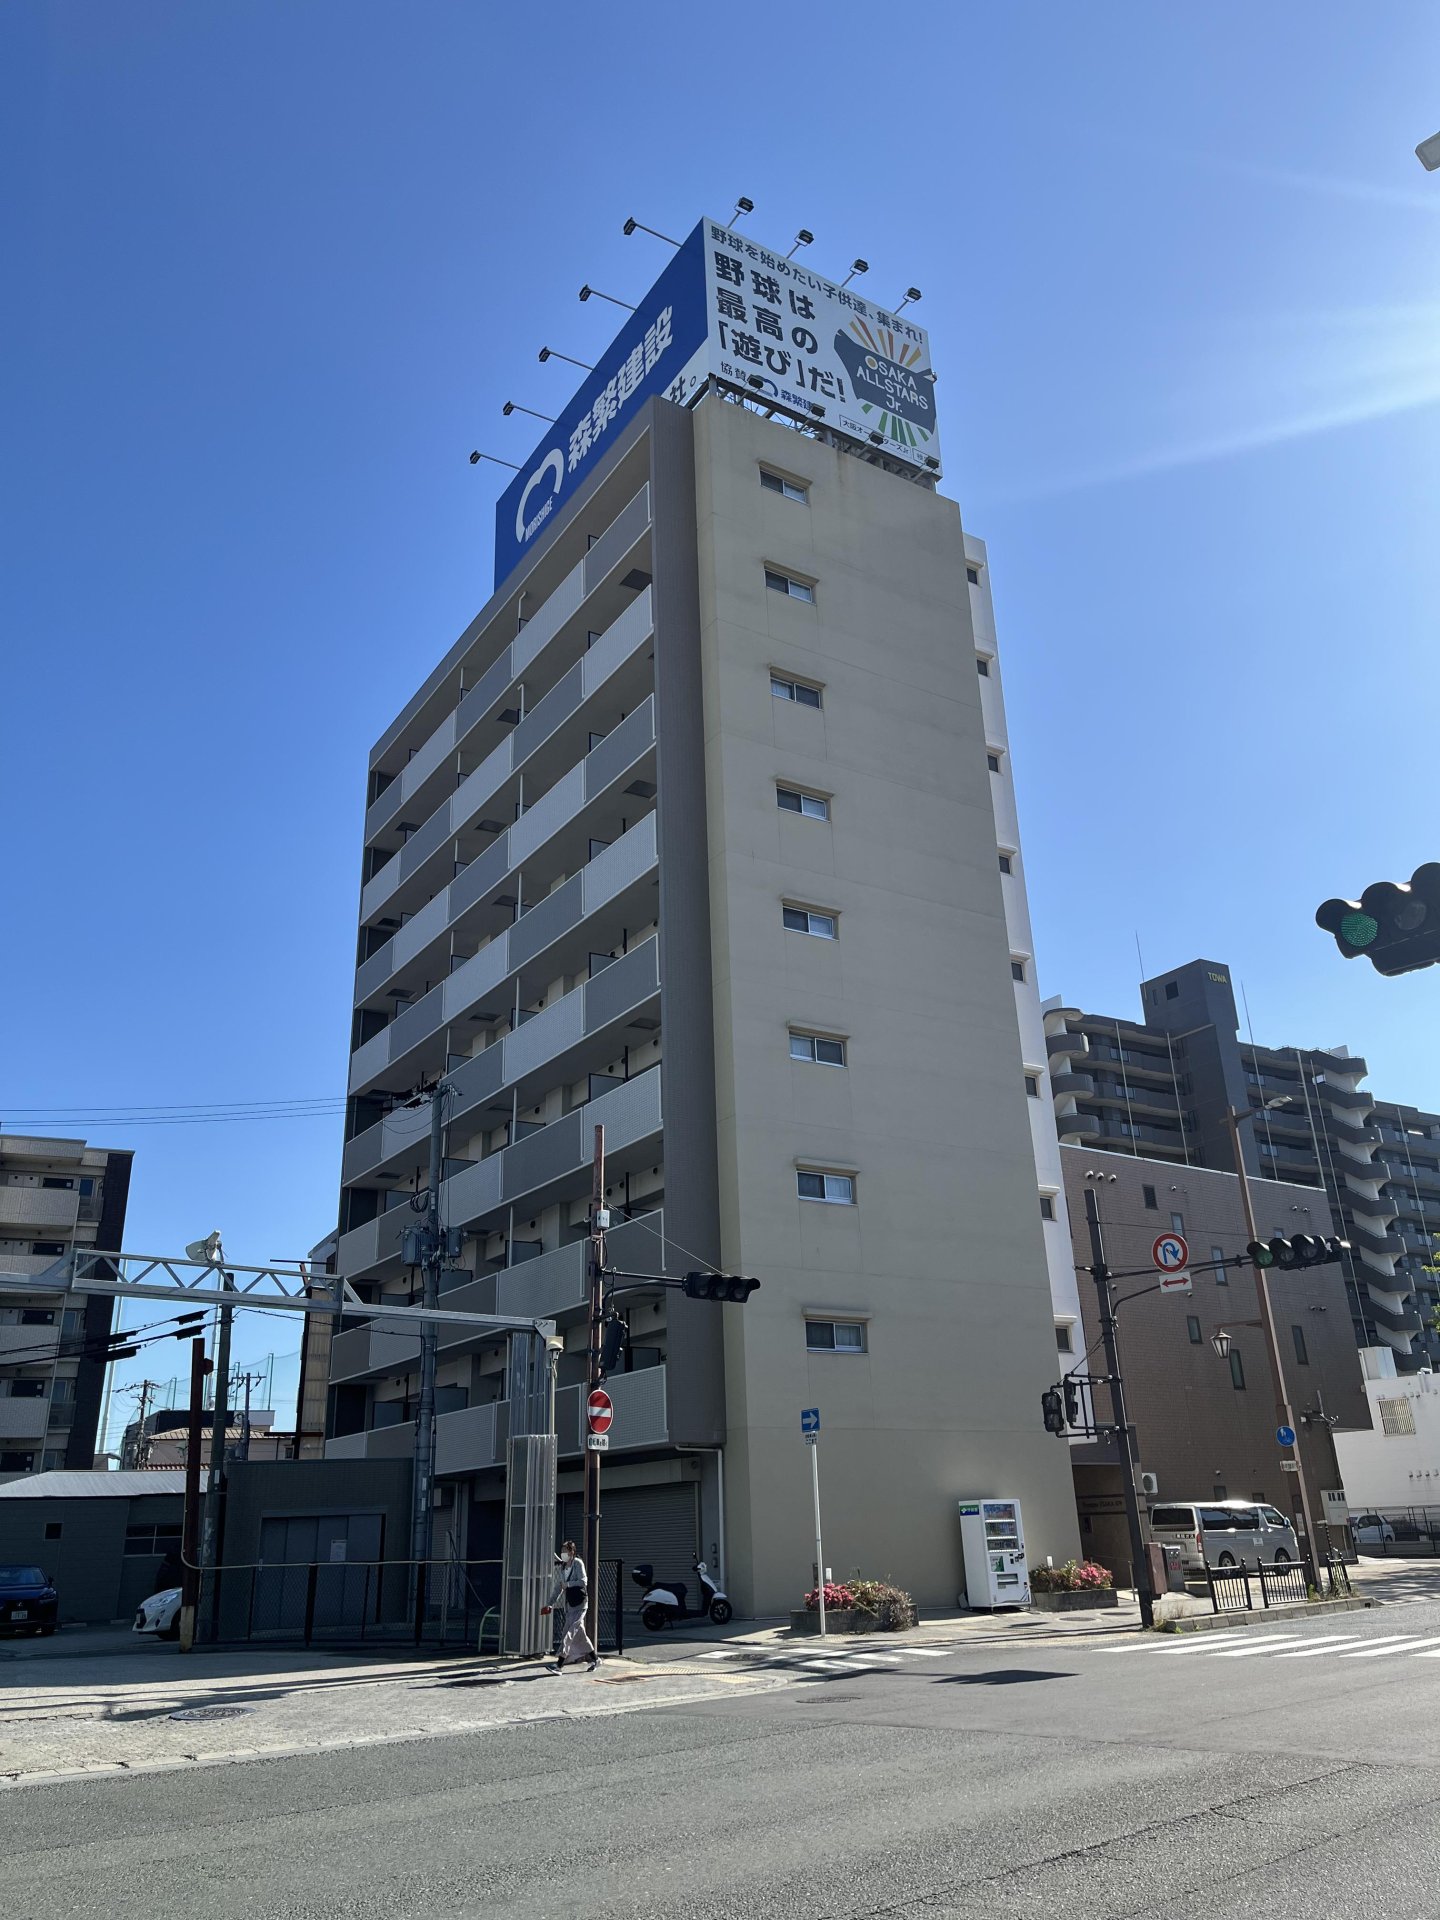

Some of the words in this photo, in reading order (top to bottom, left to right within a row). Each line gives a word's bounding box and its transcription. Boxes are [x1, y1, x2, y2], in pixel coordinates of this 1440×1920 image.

[714, 251, 816, 320] 野球は
[716, 287, 819, 354] 最高の
[856, 366, 929, 410] ALLSTARS
[865, 355, 918, 391] OSAKA
[886, 393, 903, 413] Jr.
[1207, 971, 1228, 984] TOWA
